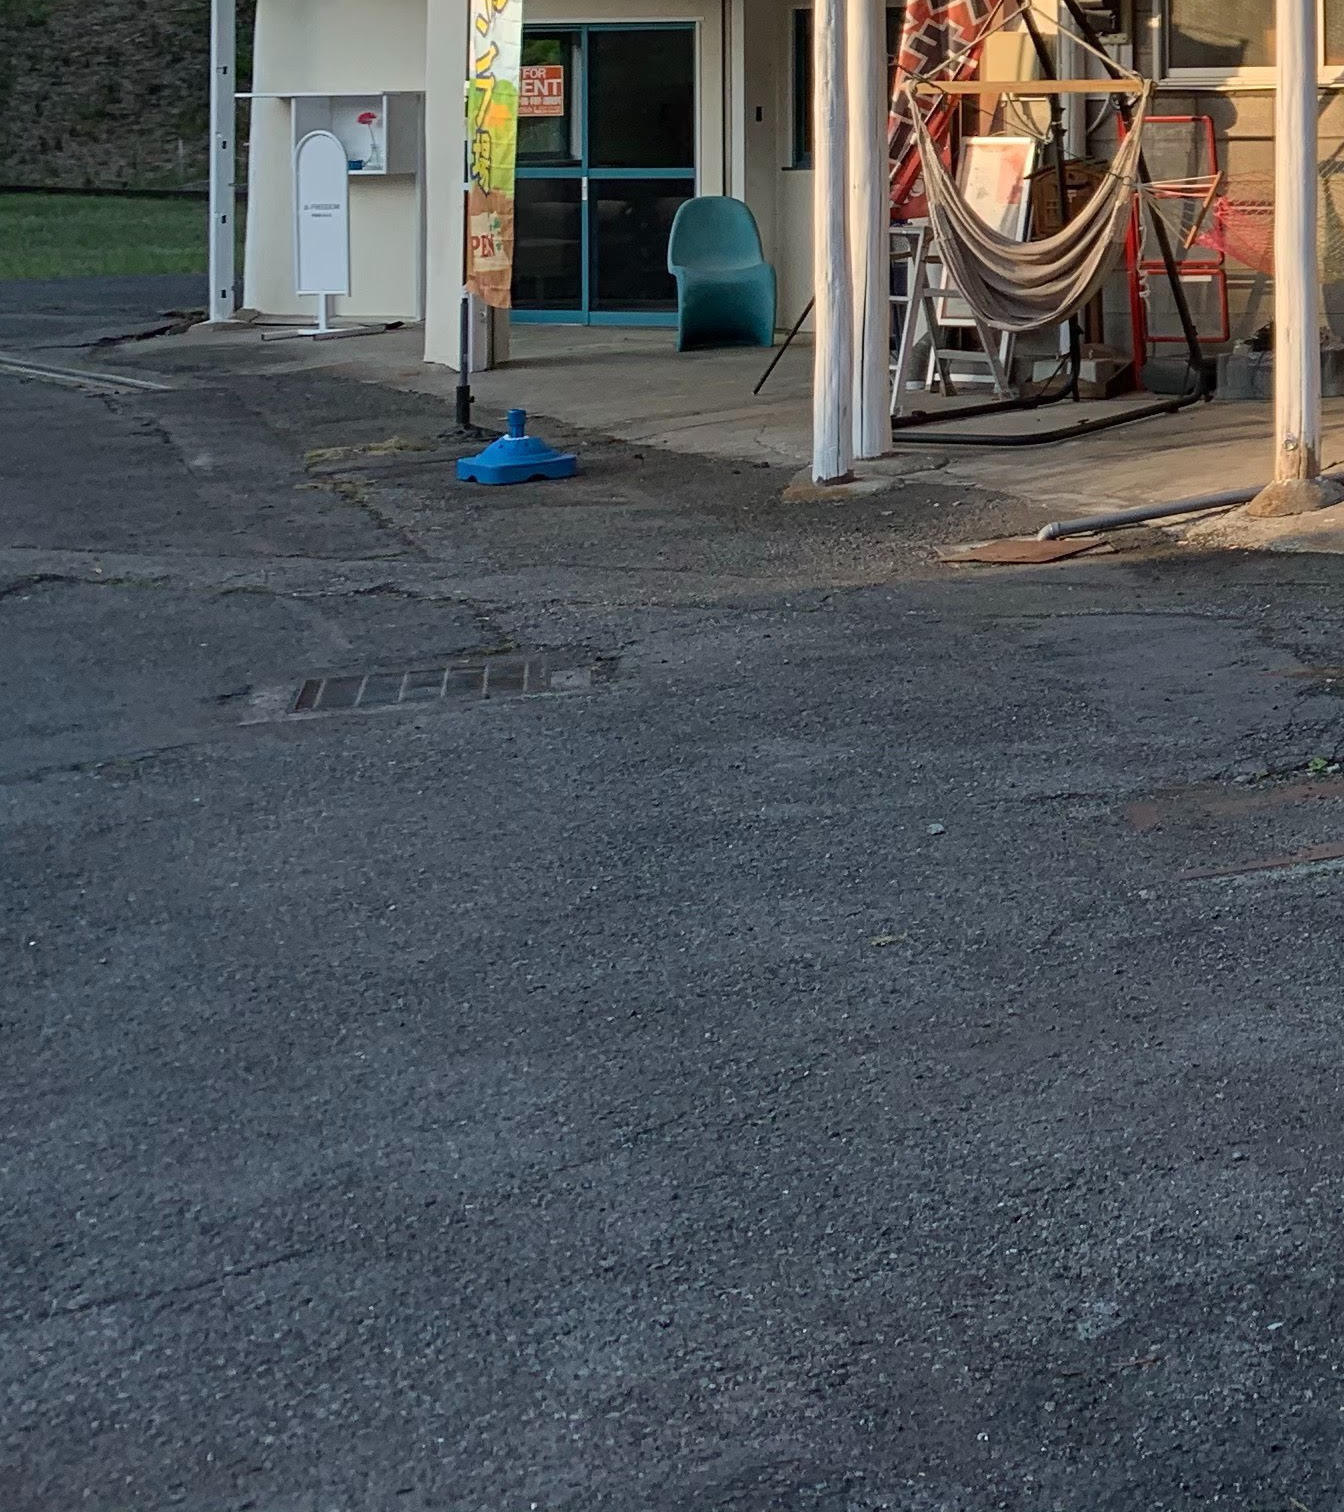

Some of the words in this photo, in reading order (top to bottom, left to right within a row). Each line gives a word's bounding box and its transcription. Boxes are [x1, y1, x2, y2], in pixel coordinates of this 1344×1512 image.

[522, 68, 546, 78] FOR
[521, 79, 561, 95] ENT
[471, 234, 495, 257] PEN
